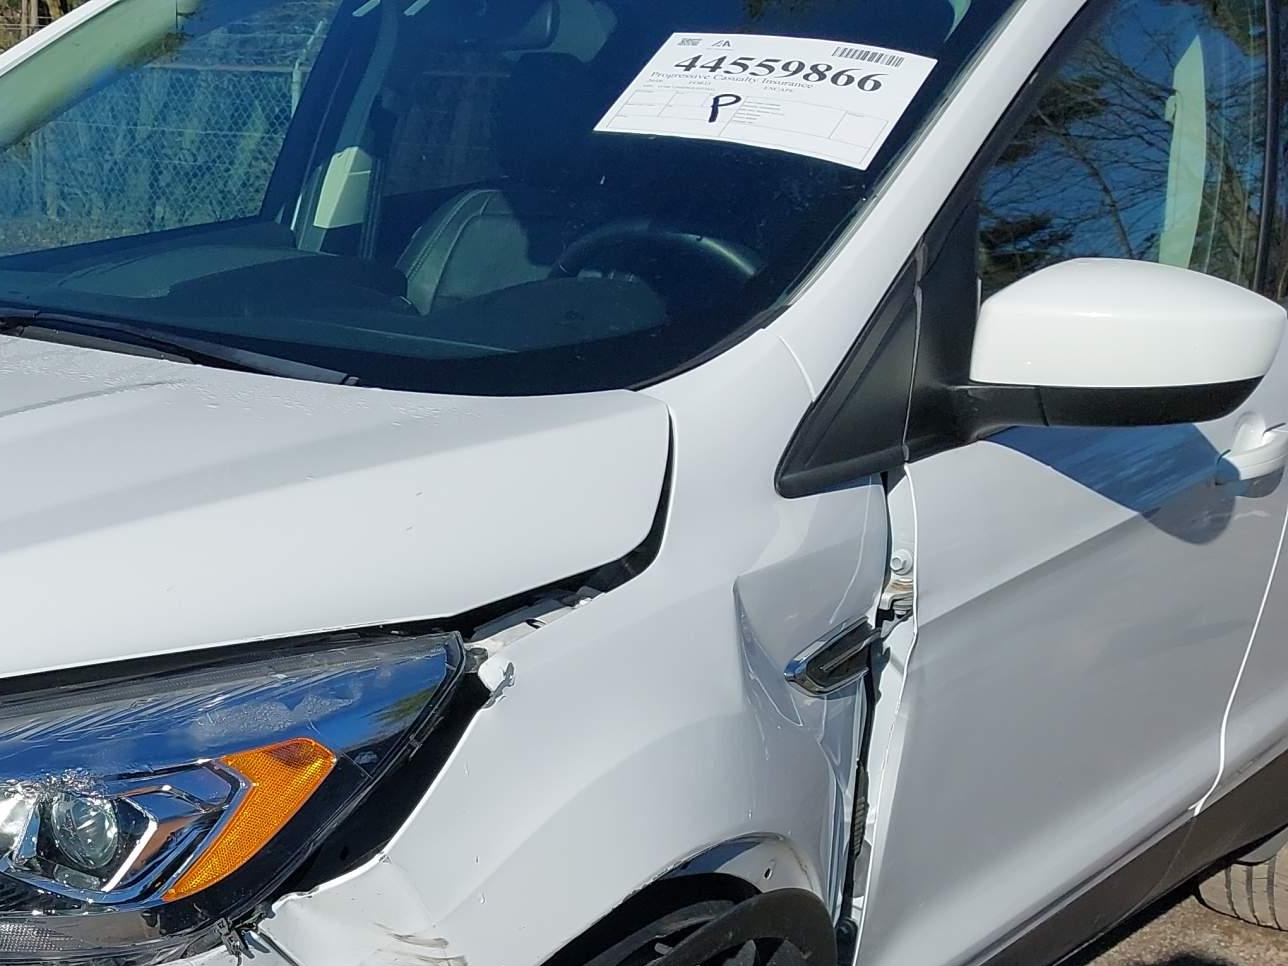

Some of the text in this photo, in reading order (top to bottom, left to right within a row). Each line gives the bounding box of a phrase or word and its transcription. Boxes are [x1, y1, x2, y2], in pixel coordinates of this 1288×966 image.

[650, 71, 814, 89] Progressive Casualty Insurance
[673, 54, 889, 92] 44559866
[708, 93, 742, 123] P
